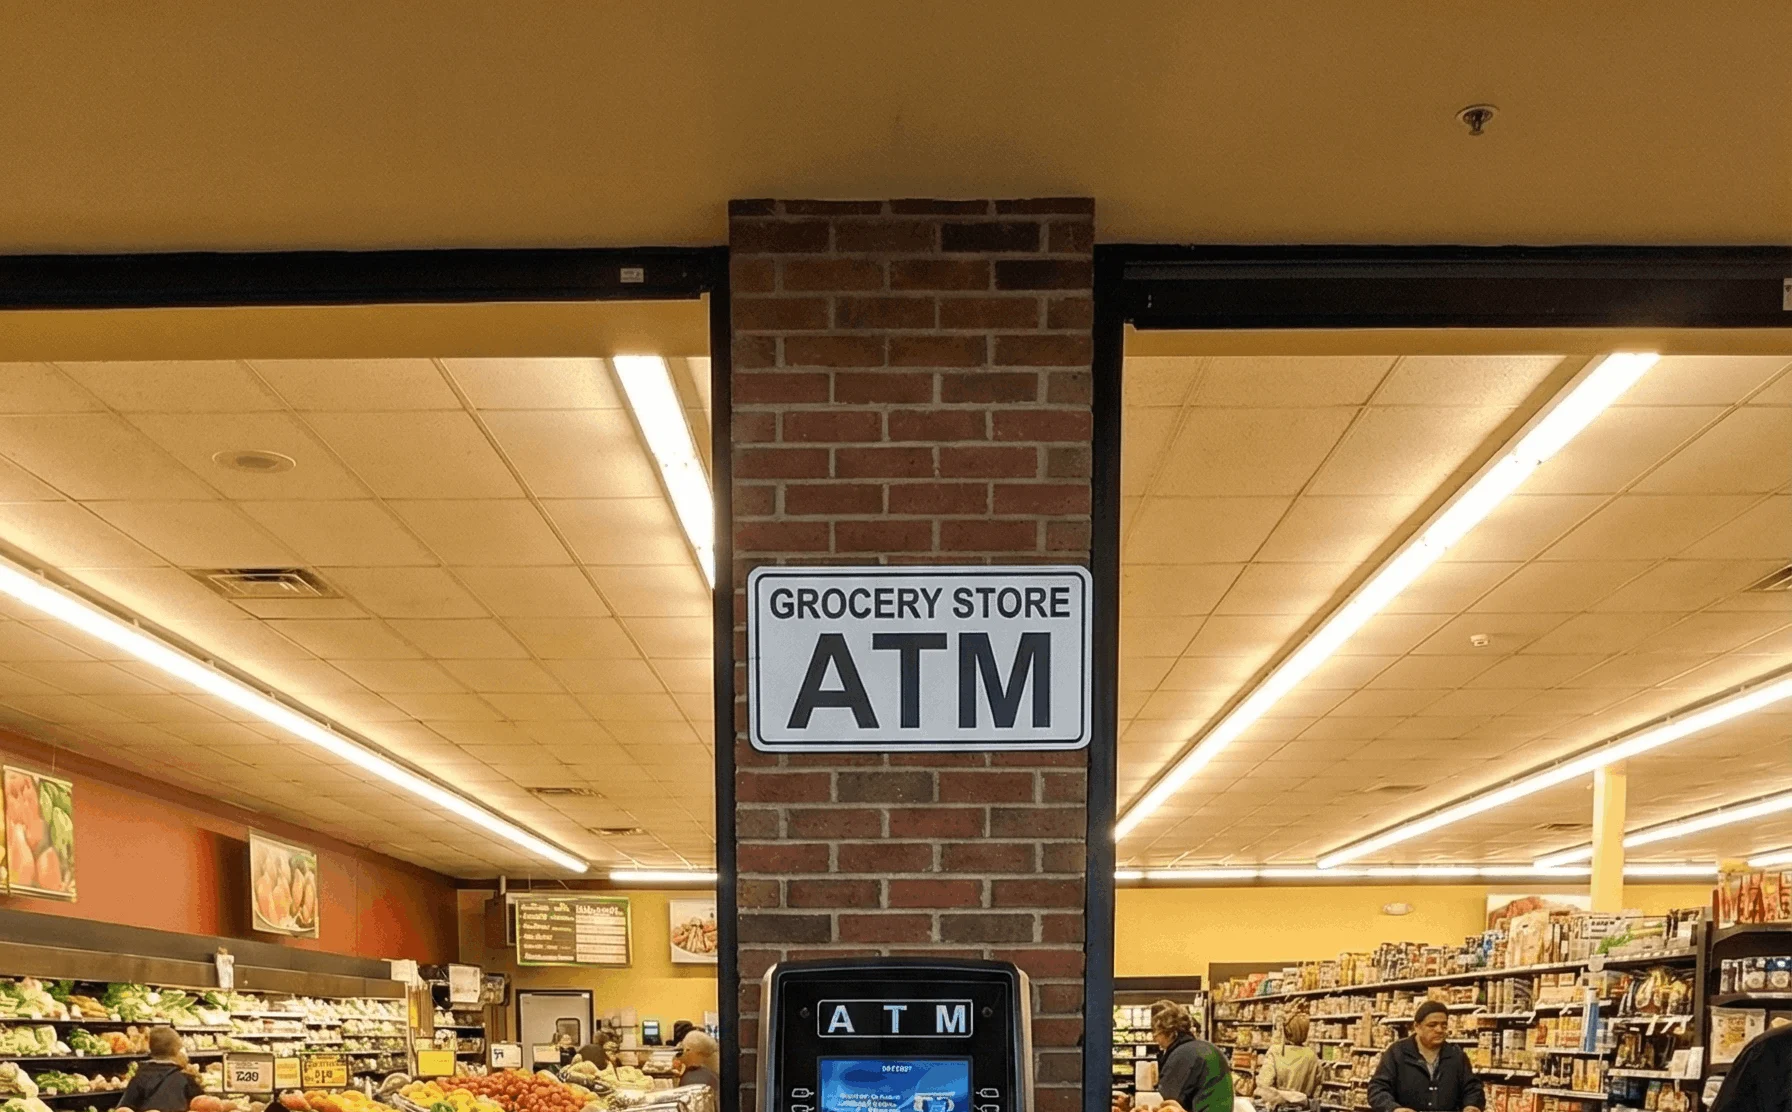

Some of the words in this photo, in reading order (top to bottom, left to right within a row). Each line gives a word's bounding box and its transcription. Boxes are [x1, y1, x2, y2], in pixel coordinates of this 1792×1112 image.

[769, 587, 942, 620] GROCERY
[952, 586, 1072, 619] STORE
[786, 631, 1053, 730] ATM
